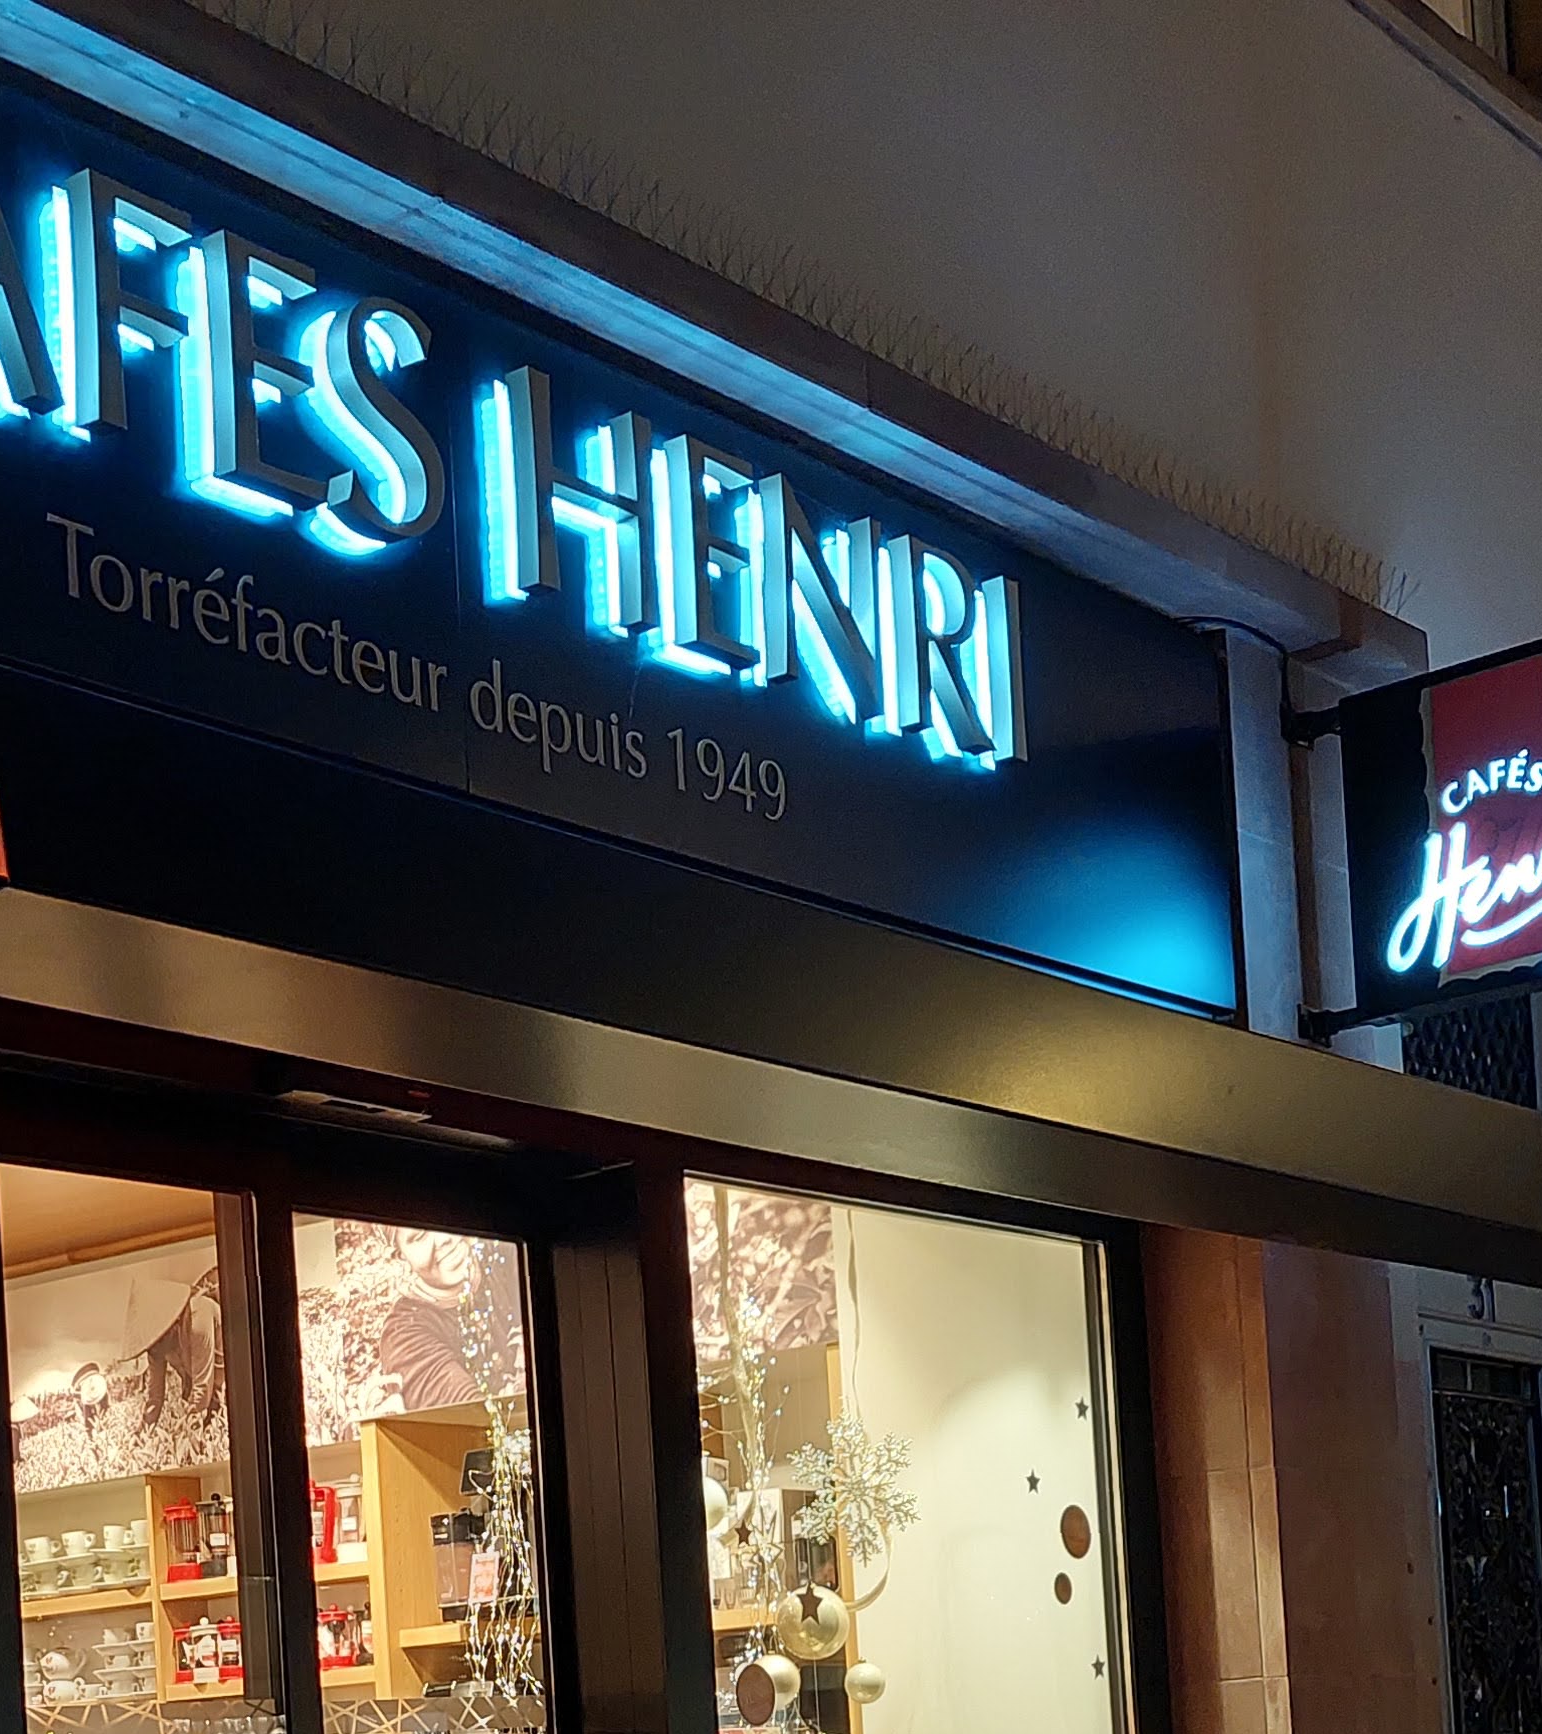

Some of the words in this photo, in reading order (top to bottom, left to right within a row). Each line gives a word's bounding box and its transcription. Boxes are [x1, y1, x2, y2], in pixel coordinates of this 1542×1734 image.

[47, 511, 451, 716] Torréfacteur
[468, 660, 649, 784] depuis
[664, 727, 790, 823] 1949
[482, 365, 1029, 772] HENRI
